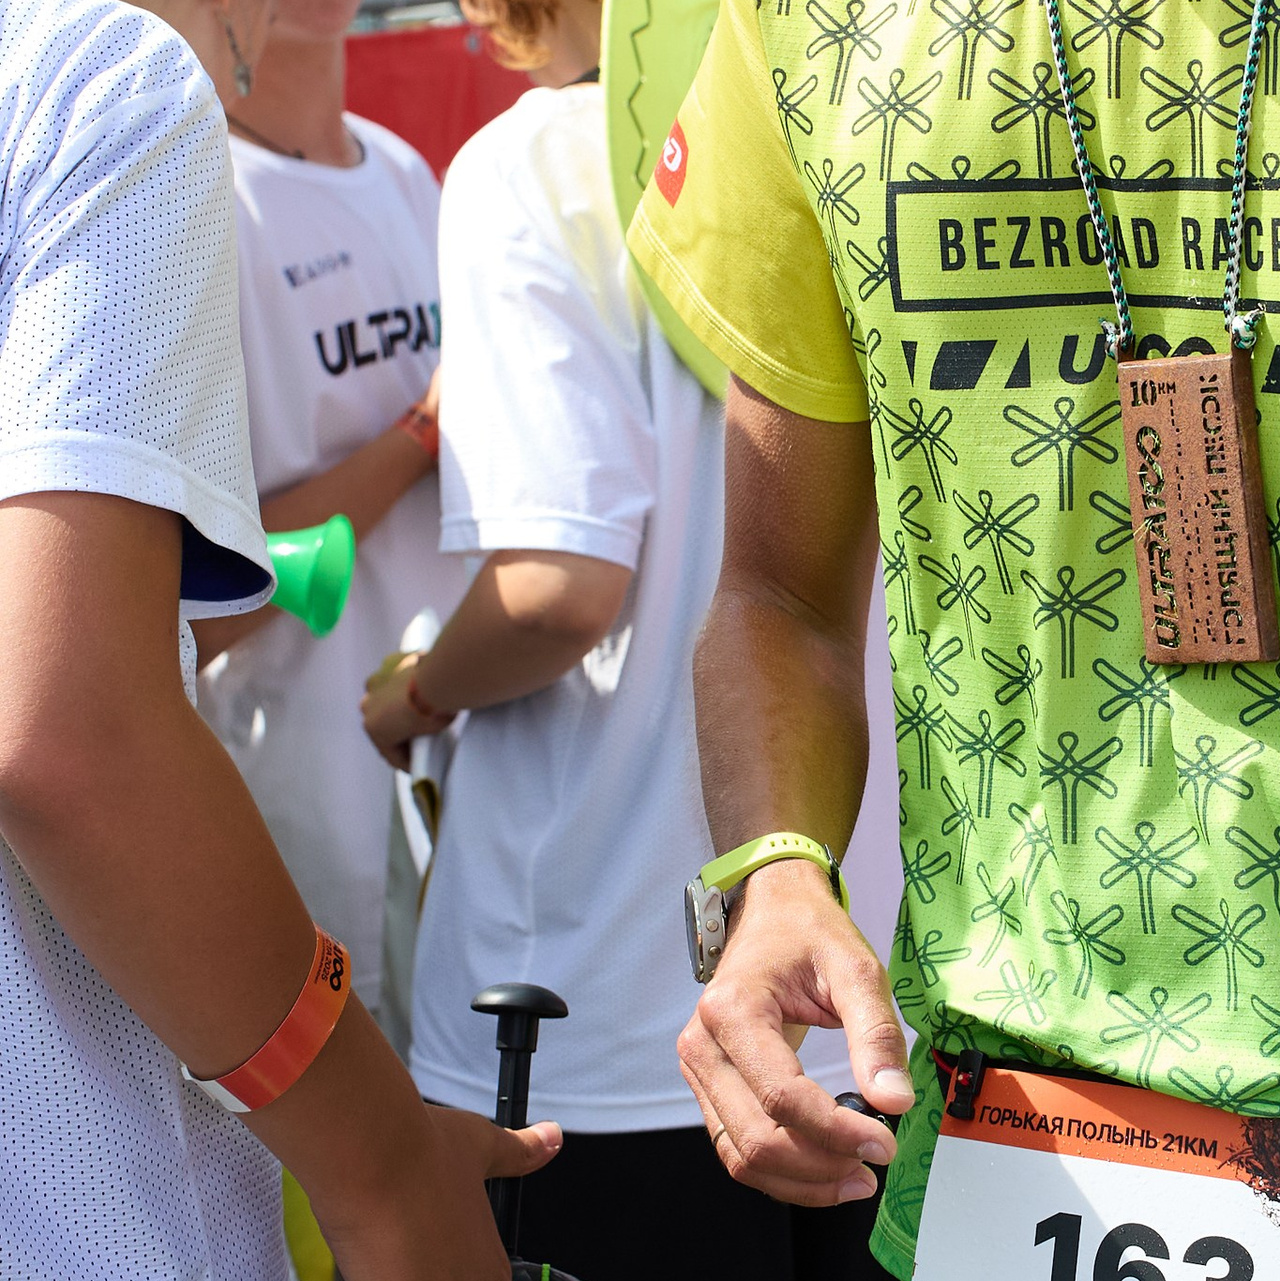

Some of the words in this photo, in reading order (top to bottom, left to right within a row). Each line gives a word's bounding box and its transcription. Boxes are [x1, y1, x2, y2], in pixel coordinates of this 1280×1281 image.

[938, 215, 1160, 271] BEZROAD
[979, 1105, 1064, 1136] ГОРЬКАЯ
[1067, 1118, 1158, 1150] ПОЛЫНЬ
[1162, 1133, 1218, 1159] 21КМ
